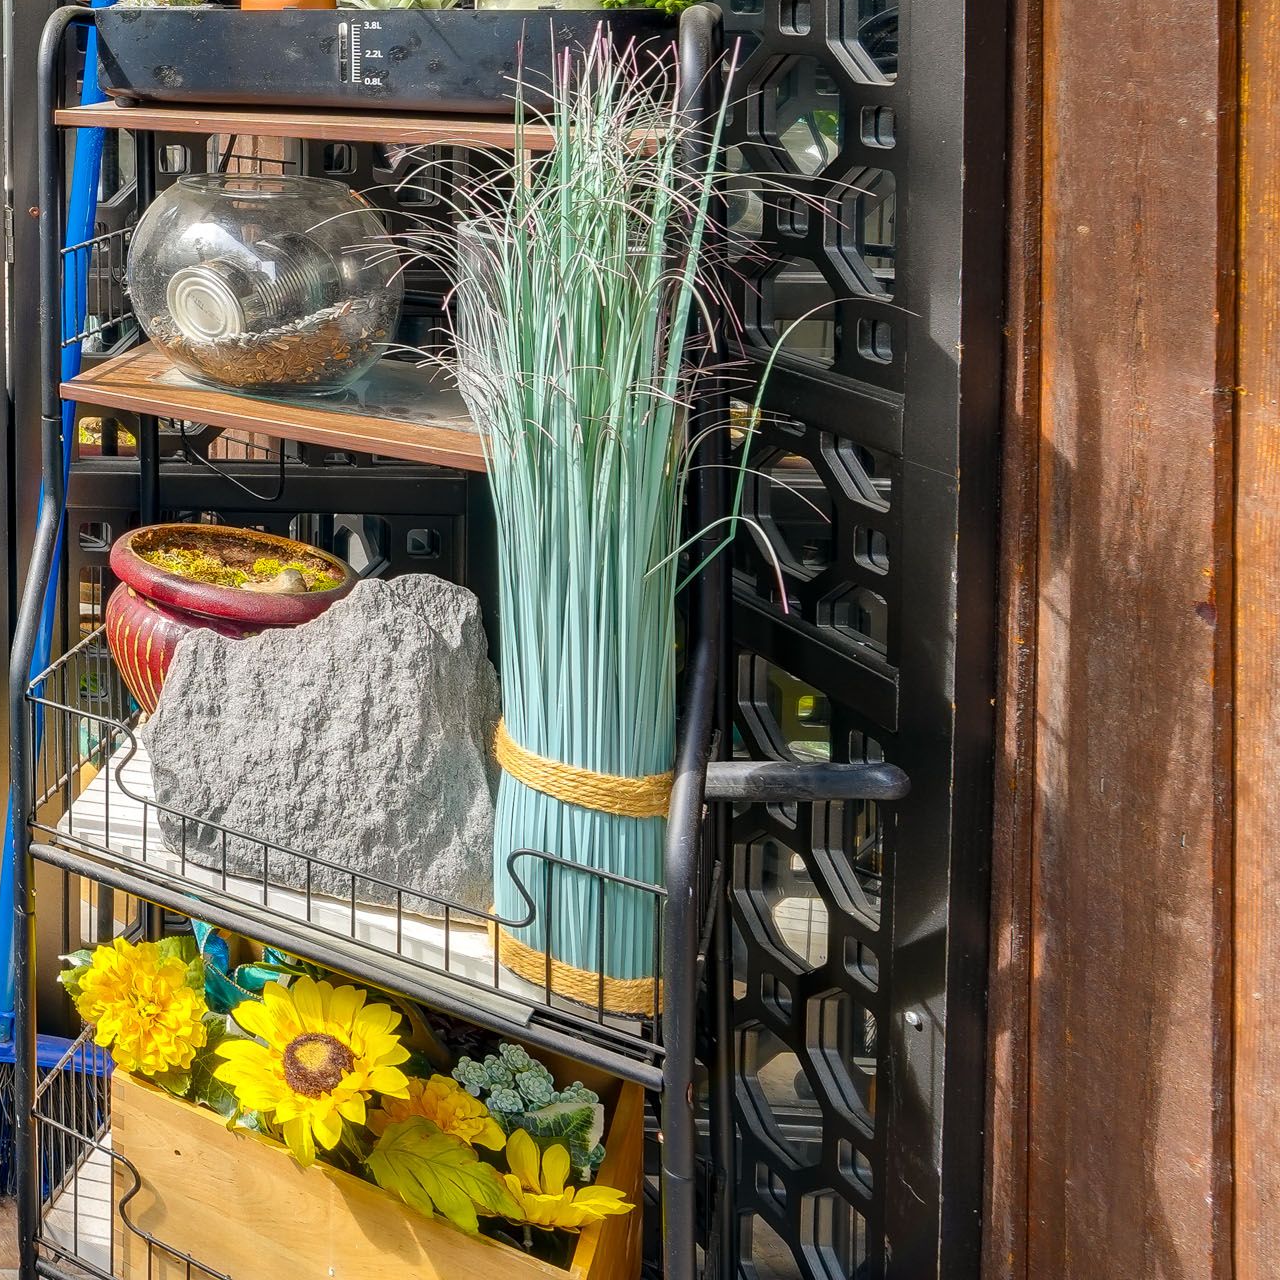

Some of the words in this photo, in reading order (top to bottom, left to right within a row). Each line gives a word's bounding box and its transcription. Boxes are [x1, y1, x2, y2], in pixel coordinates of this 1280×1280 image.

[364, 21, 382, 30] 3.8L
[365, 50, 383, 58] 2.2L
[364, 77, 382, 86] 0.8L
